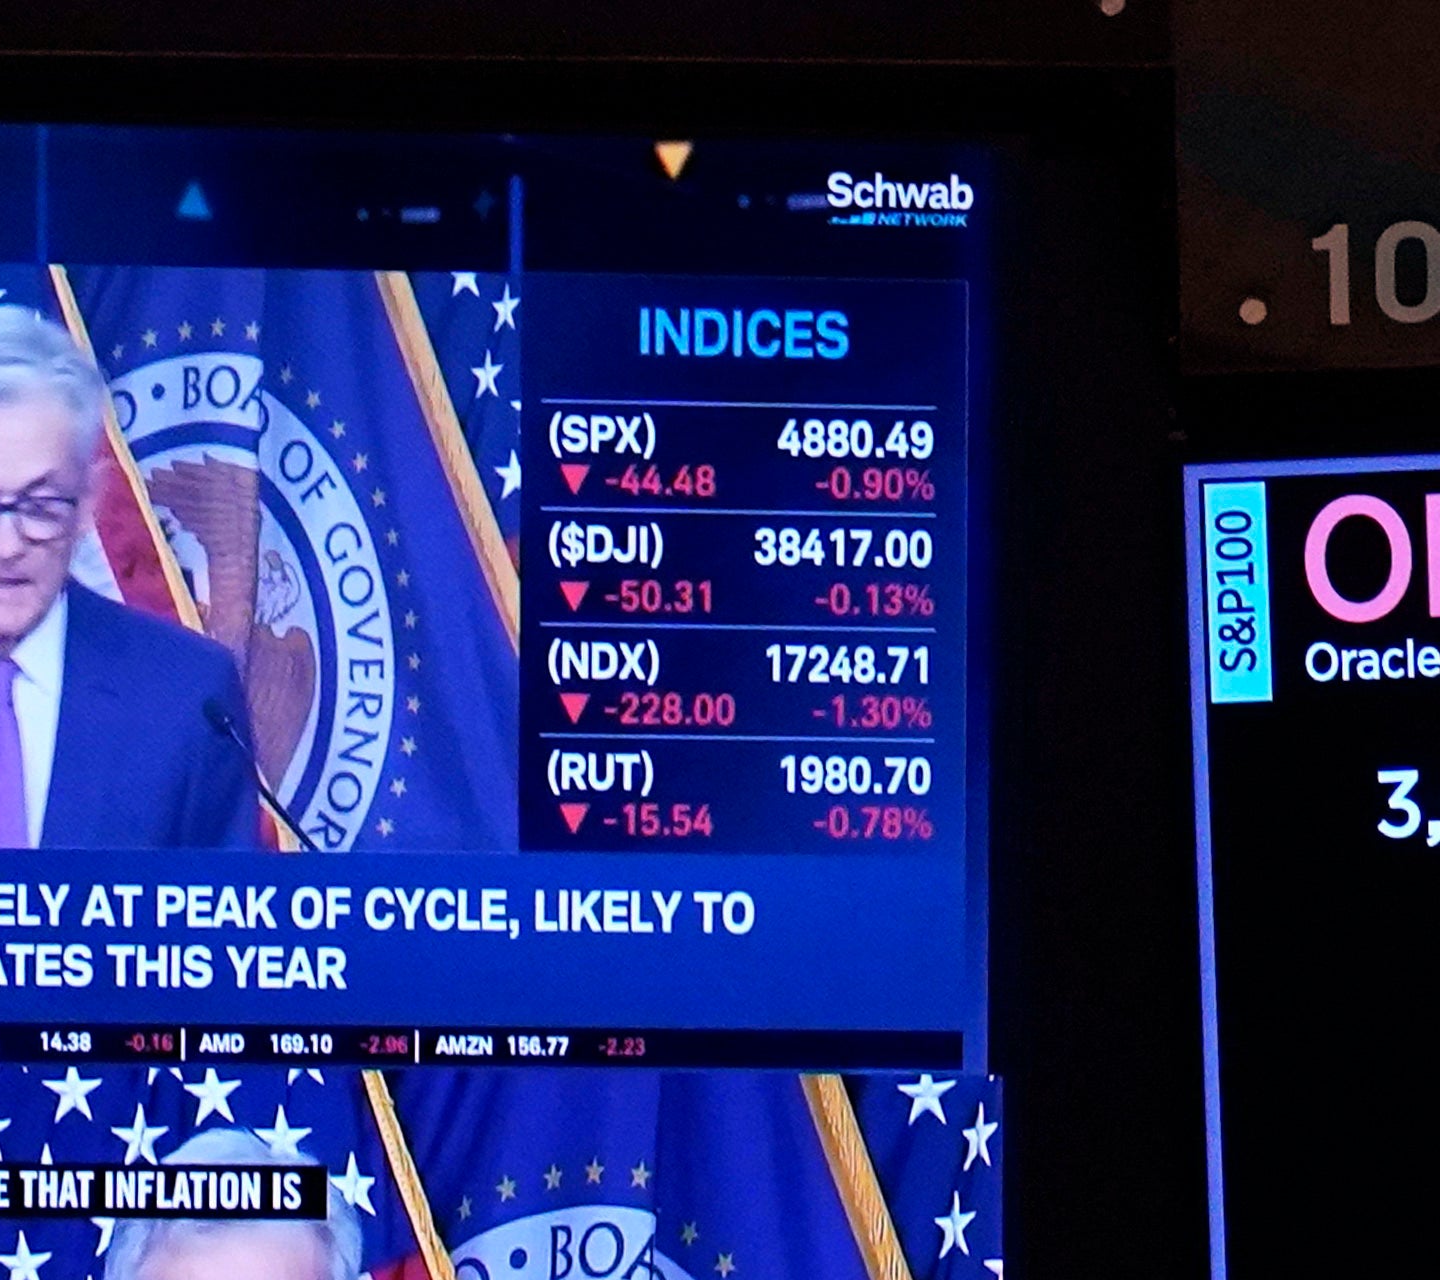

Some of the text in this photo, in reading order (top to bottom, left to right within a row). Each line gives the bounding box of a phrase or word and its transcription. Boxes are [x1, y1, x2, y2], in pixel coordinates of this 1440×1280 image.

[827, 172, 973, 210] Schwab
[639, 308, 849, 360] INDICES
[549, 411, 934, 460] (SPX) 4880.49
[549, 521, 933, 569] ($DJI) 38417.00
[1215, 510, 1256, 672] S&P100
[548, 638, 929, 685] (NDX) 17248.71
[1305, 638, 1440, 682] Oracle
[547, 749, 932, 796] (RUT) 1980.70
[82, 885, 142, 927] AT
[156, 885, 277, 928] PEAK
[291, 886, 350, 930] OF
[364, 888, 519, 938] CYCLE,
[534, 889, 681, 932] LIKELY
[694, 891, 754, 934] TO
[199, 1033, 244, 1053] AMD
[271, 1034, 332, 1054] 169.10
[435, 1035, 493, 1054] AMZN
